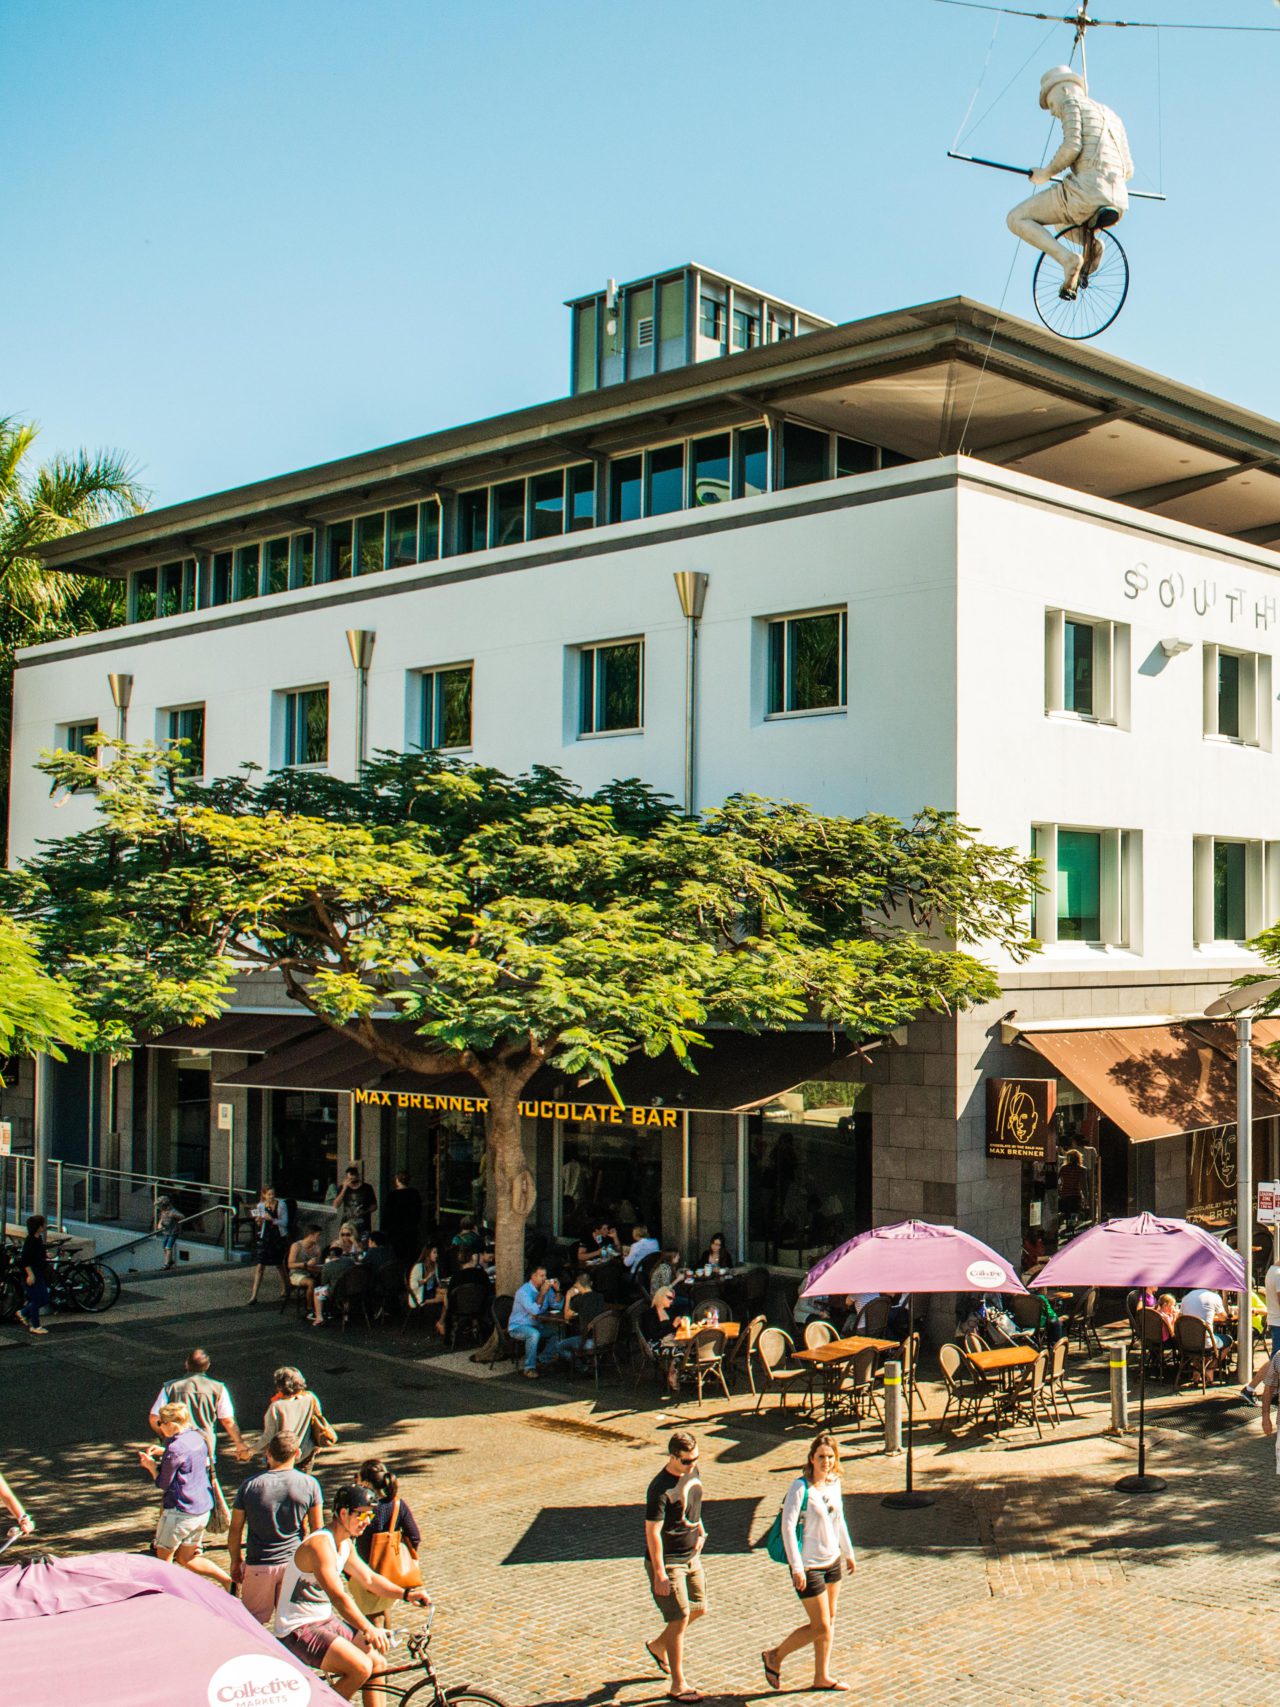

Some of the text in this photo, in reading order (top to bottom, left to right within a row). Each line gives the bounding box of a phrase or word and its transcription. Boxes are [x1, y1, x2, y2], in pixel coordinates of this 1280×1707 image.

[1123, 568, 1268, 631] SOUTH
[355, 1087, 678, 1128] MAX BRENNER OCOLATE BAR
[1007, 1149, 1044, 1157] BRENNER
[217, 1678, 300, 1702] Collective
[236, 1695, 288, 1707] MARKETS
